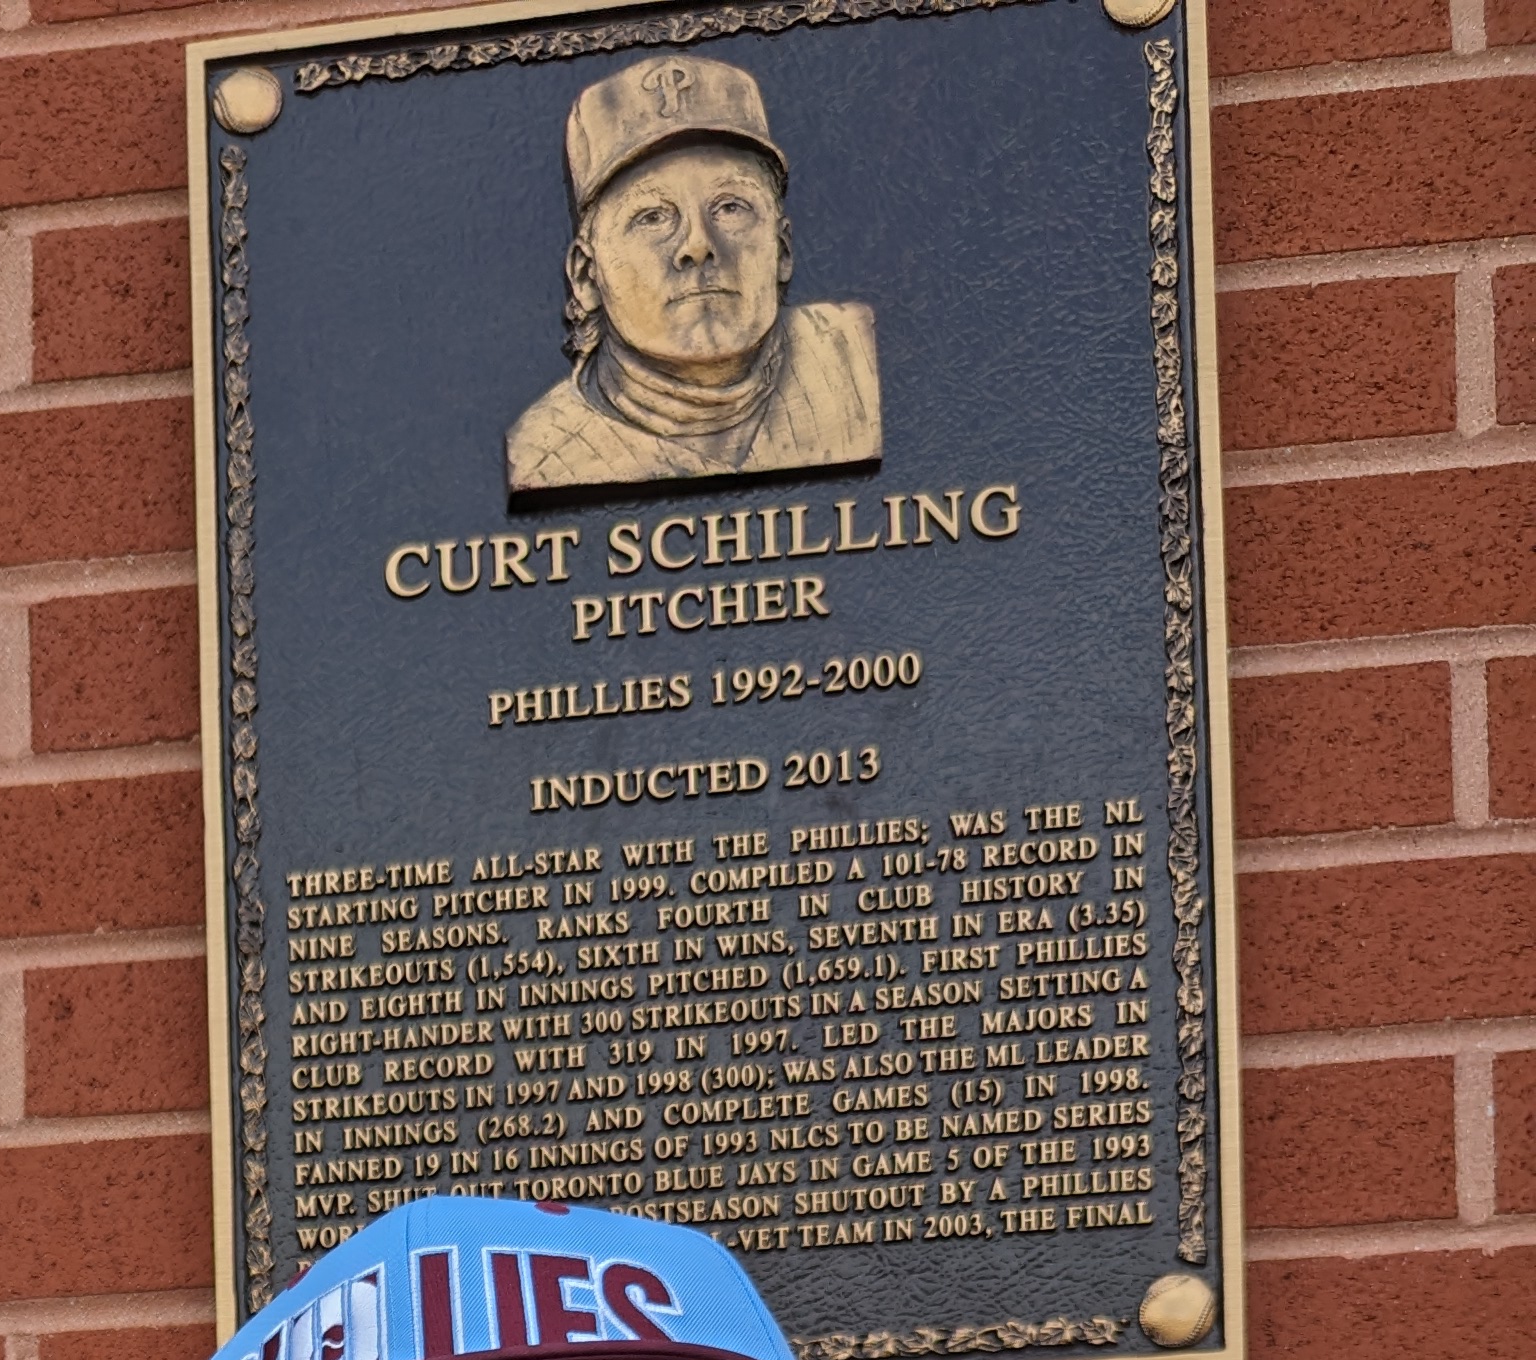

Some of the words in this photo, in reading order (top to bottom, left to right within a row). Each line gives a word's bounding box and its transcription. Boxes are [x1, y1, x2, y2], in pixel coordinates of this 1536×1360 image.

[385, 528, 579, 597] CURT
[608, 484, 1022, 574] SCHILLING
[572, 575, 829, 640] PITCHER
[488, 674, 691, 725] PHILLIES
[712, 651, 922, 703] 1992-2000
[530, 756, 769, 810] INDUCTED
[784, 745, 880, 786] 2013
[285, 857, 453, 897] THREE-TIME
[471, 845, 601, 881] ALL-STAR
[621, 837, 694, 866] WITH
[712, 829, 770, 858] THE
[790, 816, 930, 852] PHILLIES;
[949, 809, 1007, 836] WAS
[1023, 801, 1082, 830] THE
[1103, 796, 1144, 824] NL
[291, 997, 348, 1025] AND
[359, 987, 463, 1019] EIGHTH
[475, 984, 507, 1010] IN
[519, 972, 634, 1006] INNINGS
[647, 963, 769, 995] PITCHED
[781, 952, 905, 987] (1,659.1).
[921, 941, 1001, 973] FIRST
[1016, 931, 1149, 965] PHILLIES
[292, 1085, 457, 1121] STRIKEOUTS
[464, 1083, 495, 1108] IN
[505, 1077, 560, 1105] 1997
[567, 1072, 627, 1100] AND
[635, 1067, 693, 1095] 1998
[700, 1061, 774, 1092] (300);
[782, 1055, 836, 1083] WAS
[843, 1050, 914, 1079] ALSO
[919, 1043, 976, 1072] THE
[985, 1042, 1025, 1067] ML
[1035, 1030, 1150, 1064] LEADER
[294, 1154, 403, 1185] FANNED
[414, 1151, 440, 1176] 19
[450, 1149, 479, 1174] IN
[492, 1146, 519, 1171] 16
[528, 1135, 644, 1168] INNINGS
[653, 1133, 689, 1159] OF
[702, 1128, 757, 1155] 1993
[769, 1120, 840, 1150] NLCS
[846, 1118, 887, 1144] TO
[895, 1116, 929, 1141] BE
[940, 1107, 1045, 1138] NAMED
[1052, 1097, 1154, 1129] SERIES
